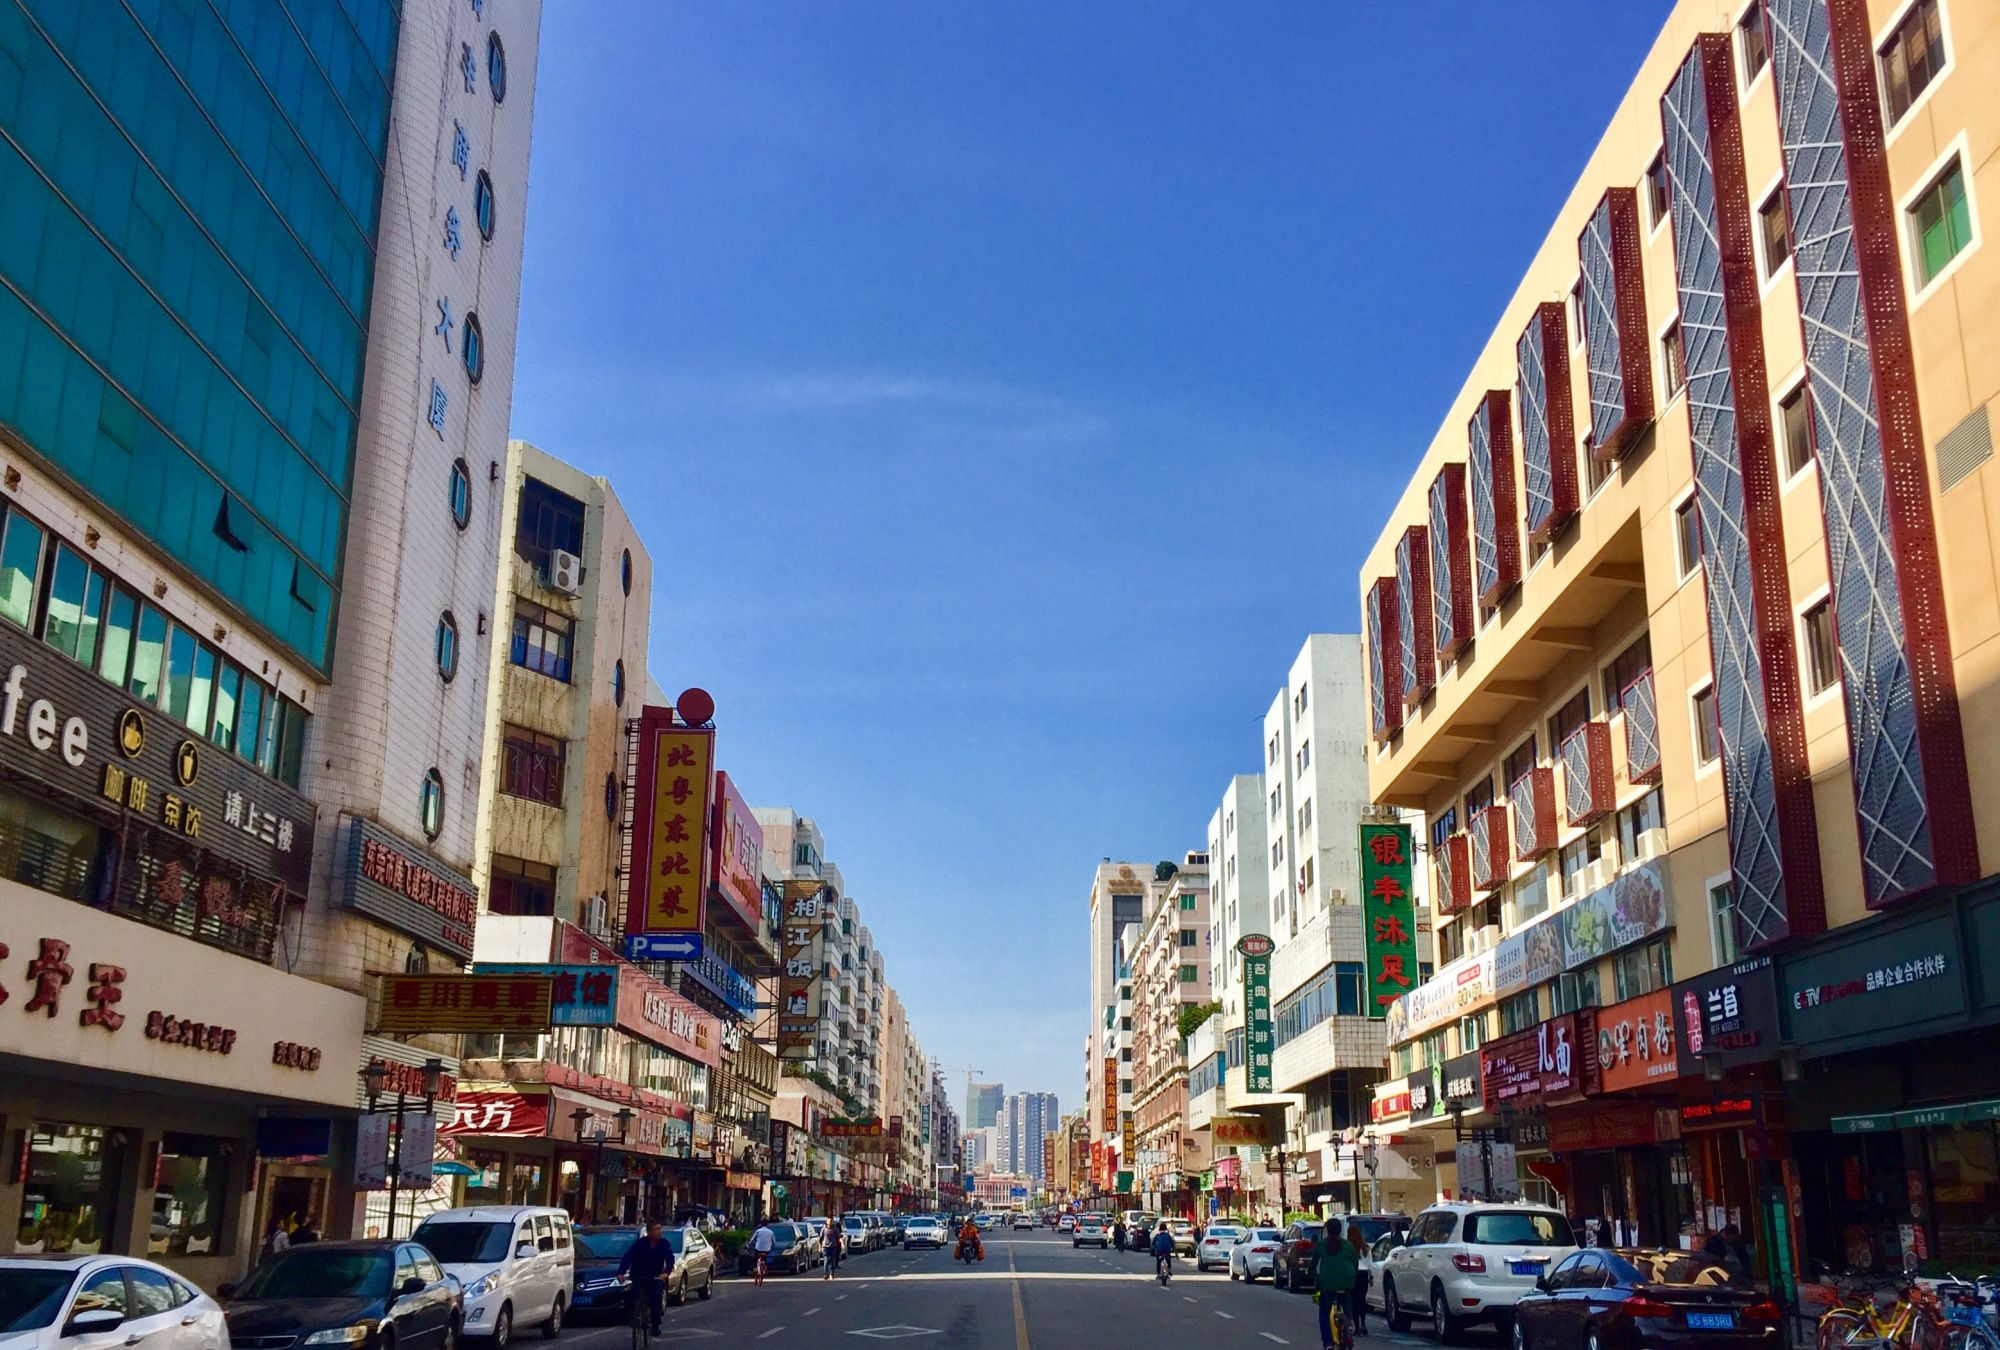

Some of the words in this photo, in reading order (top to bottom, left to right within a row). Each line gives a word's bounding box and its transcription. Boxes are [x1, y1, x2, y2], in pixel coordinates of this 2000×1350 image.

[104, 764, 149, 813] 咖啡
[224, 790, 294, 853] 请上三楼
[659, 743, 697, 919] 北粤东北菜
[786, 897, 818, 1015] 湘江饭店
[1246, 963, 1254, 986] MING
[1866, 953, 1946, 991] 品牌企业合作伙伴
[0, 937, 128, 1032] 骨王
[1248, 1044, 1256, 1089] LANGUAGE
[436, 1100, 515, 1130] 元方
